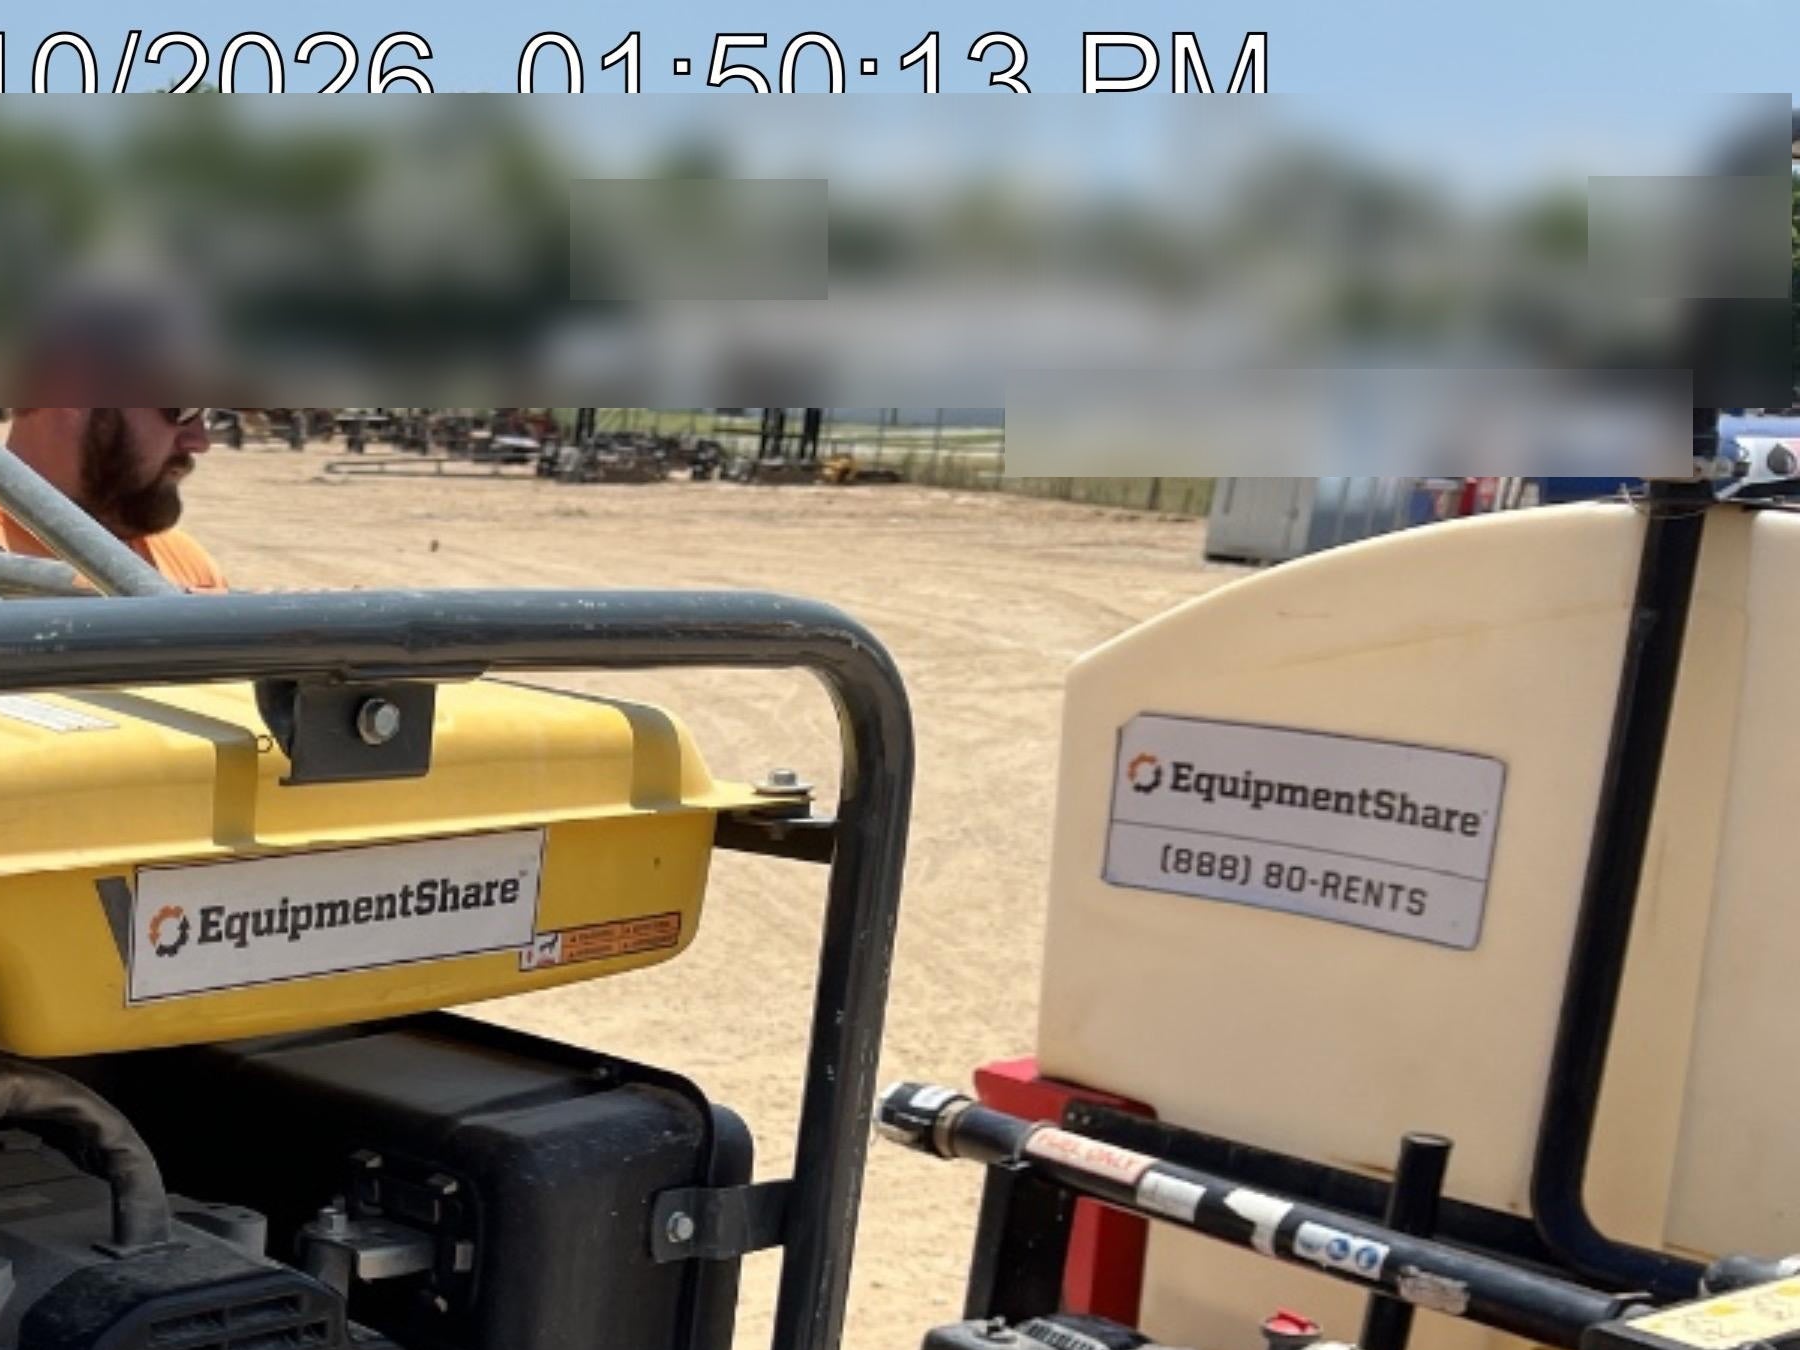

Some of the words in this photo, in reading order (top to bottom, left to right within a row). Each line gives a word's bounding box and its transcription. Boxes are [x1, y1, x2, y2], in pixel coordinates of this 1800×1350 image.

[1169, 760, 1482, 838] EquipmentShare
[197, 875, 520, 946] EquipmentShare
[1160, 843, 1252, 886] (888)
[1263, 860, 1429, 917] 80-RENTS
